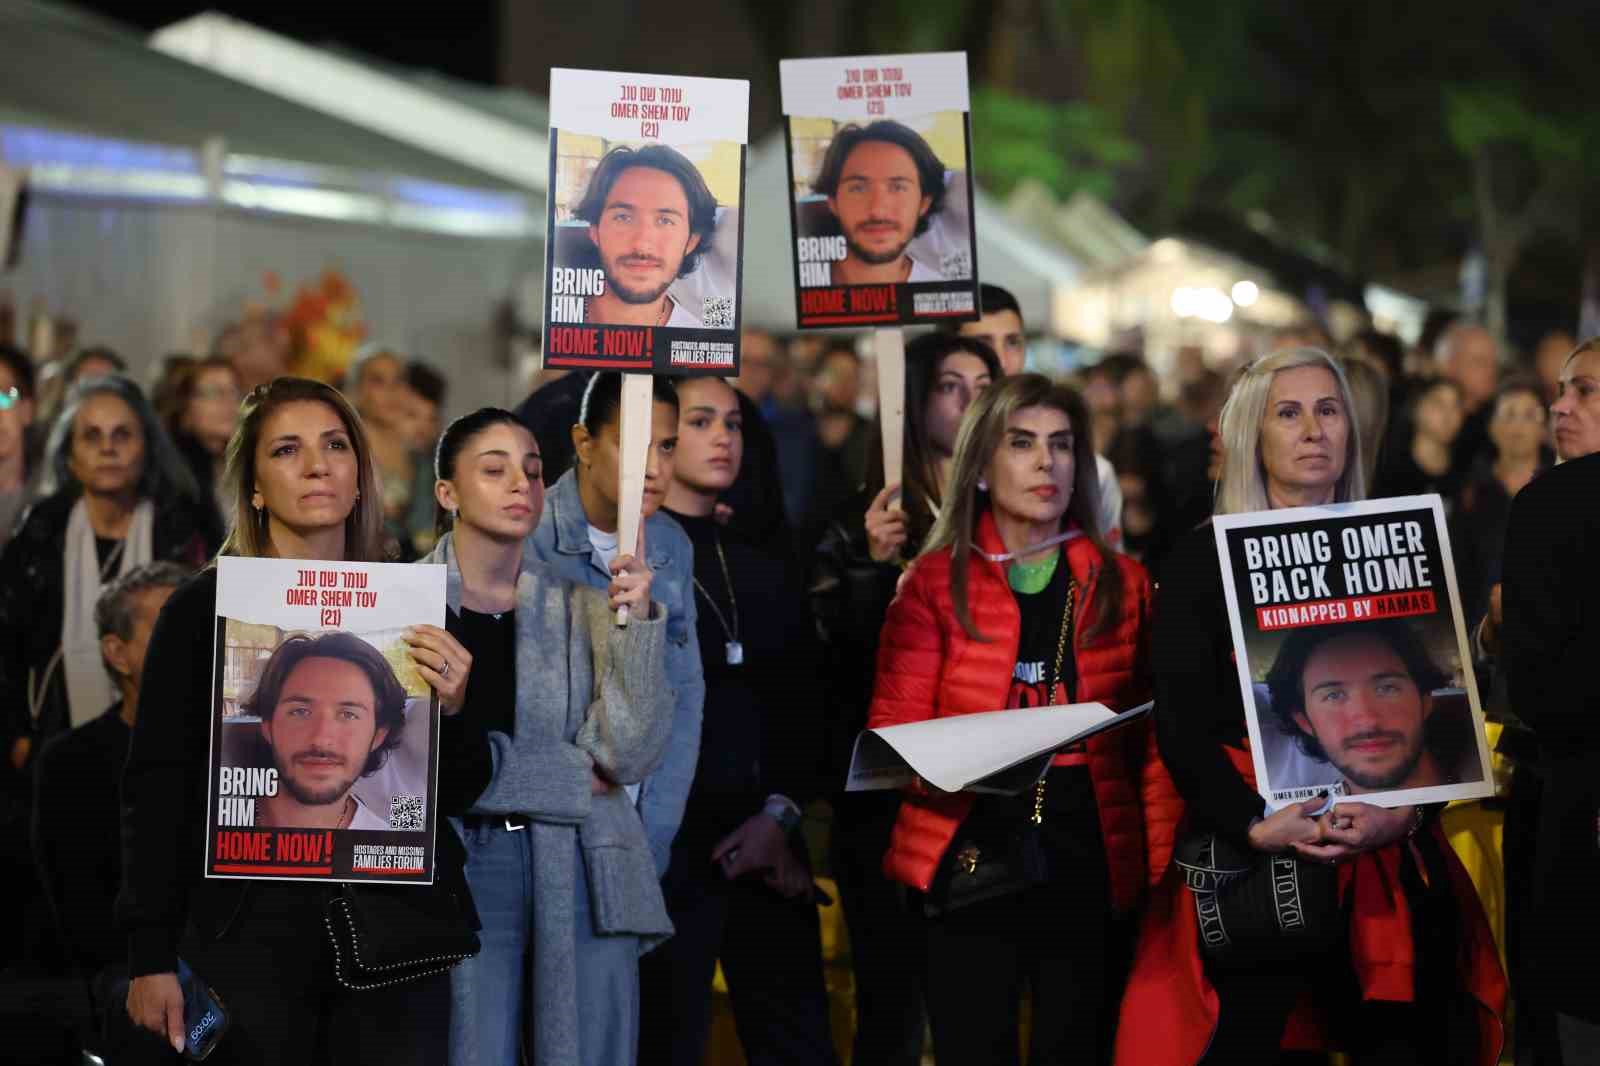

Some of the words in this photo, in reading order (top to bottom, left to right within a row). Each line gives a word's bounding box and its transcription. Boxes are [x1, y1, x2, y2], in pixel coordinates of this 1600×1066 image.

[620, 85, 637, 101] טוב
[640, 86, 656, 102] שם
[659, 87, 682, 103] עומר
[837, 85, 863, 100] OMER
[866, 84, 891, 98] SHEM
[894, 83, 912, 97] TOV
[611, 102, 638, 118] OMER
[641, 104, 668, 120] SHEM
[672, 106, 690, 122] TOV
[641, 122, 659, 138] (21)
[798, 236, 847, 262] BRING
[552, 268, 604, 296] BRING
[800, 262, 831, 287] HIM
[551, 294, 584, 323] HIM
[802, 288, 846, 313] HOME
[851, 284, 897, 312] NOW!
[550, 327, 598, 355] HOME
[603, 328, 653, 357] NOW!
[671, 350, 705, 364] FAMILIES
[706, 351, 734, 365] FORUM
[1243, 530, 1332, 570] BRING
[1342, 521, 1425, 560] OMER
[297, 570, 316, 586] טוב
[320, 571, 338, 588] שם
[341, 572, 368, 588] עומר
[1250, 565, 1332, 604] BACK
[1342, 555, 1432, 595] HOME
[286, 589, 318, 606] OMER
[321, 590, 352, 607] SHEM
[356, 591, 377, 608] TOV
[320, 608, 342, 627] (21)
[1262, 602, 1348, 627] KIDNAPPED
[1352, 600, 1372, 618] BY
[1377, 593, 1431, 614] HAMAS
[1012, 662, 1046, 684] OME
[220, 766, 278, 797] BRING
[217, 797, 256, 826] HIM
[216, 831, 272, 861] HOME
[277, 831, 334, 864] NOW!
[354, 844, 384, 855] HOSTAGES
[384, 846, 398, 856] AND
[398, 846, 424, 856] MISSING
[353, 854, 392, 869] FAMILIES
[393, 856, 424, 870] FORUM
